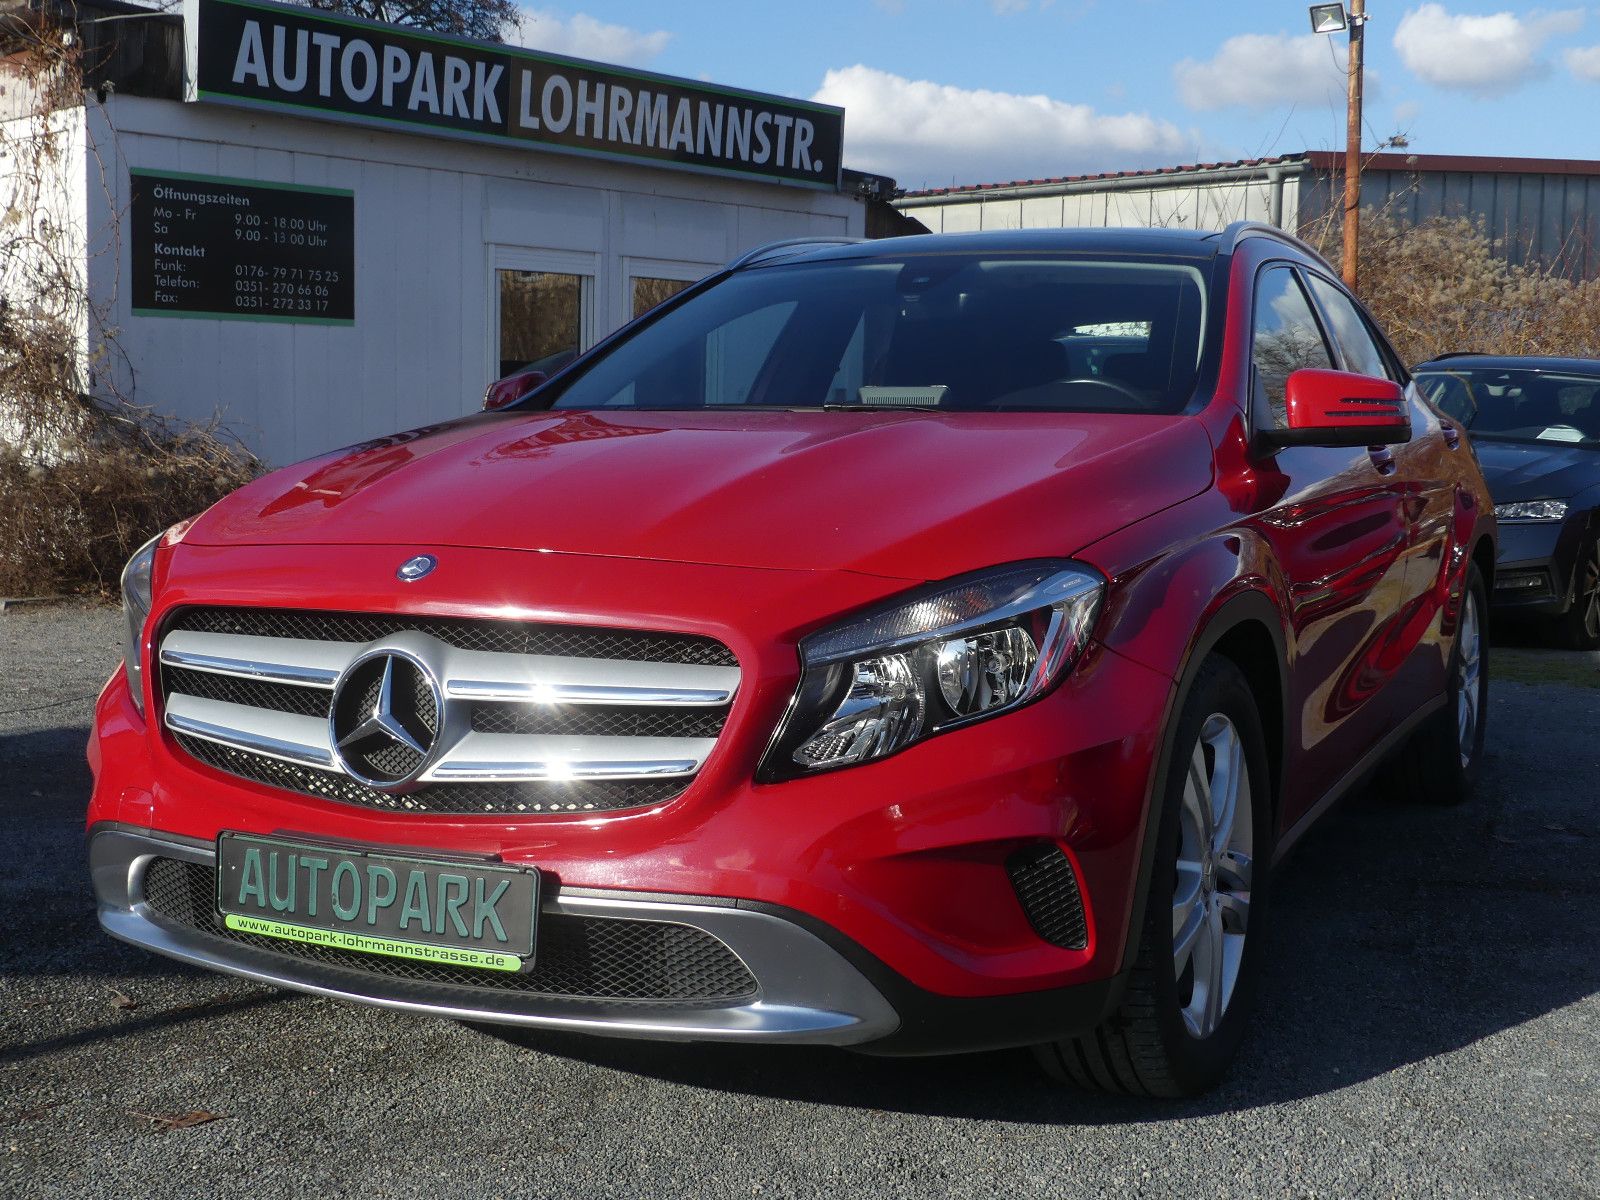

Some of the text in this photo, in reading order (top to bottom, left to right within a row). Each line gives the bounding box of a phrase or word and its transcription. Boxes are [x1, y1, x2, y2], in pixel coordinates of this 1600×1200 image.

[231, 19, 823, 172] AUTOPARK LOHRMANNSTR.
[153, 184, 250, 206] Öffnungszeiten
[153, 207, 172, 218] Mo
[185, 208, 197, 220] Fr
[235, 213, 261, 226] 9.00
[273, 216, 304, 230] 18.00
[308, 220, 328, 232] Uhr
[154, 222, 168, 234] Sa
[235, 229, 261, 241] 9.00
[308, 234, 328, 247] Uhr
[154, 243, 205, 257] Kontakt
[154, 258, 186, 272] Funk:
[273, 267, 287, 279] 79
[290, 268, 303, 279] 71
[308, 269, 322, 281] 75
[325, 271, 339, 283] 25
[154, 275, 201, 289] Telefon:
[273, 282, 294, 295] 270
[298, 284, 312, 296] 66
[315, 285, 329, 297] 06
[154, 290, 178, 303] Fax:
[273, 297, 294, 310] 272
[298, 299, 312, 311] 33
[317, 300, 329, 312] 17
[238, 848, 511, 943] AUTOPARK
[238, 919, 505, 967] www.autopark-lohrmannstrasse.de
